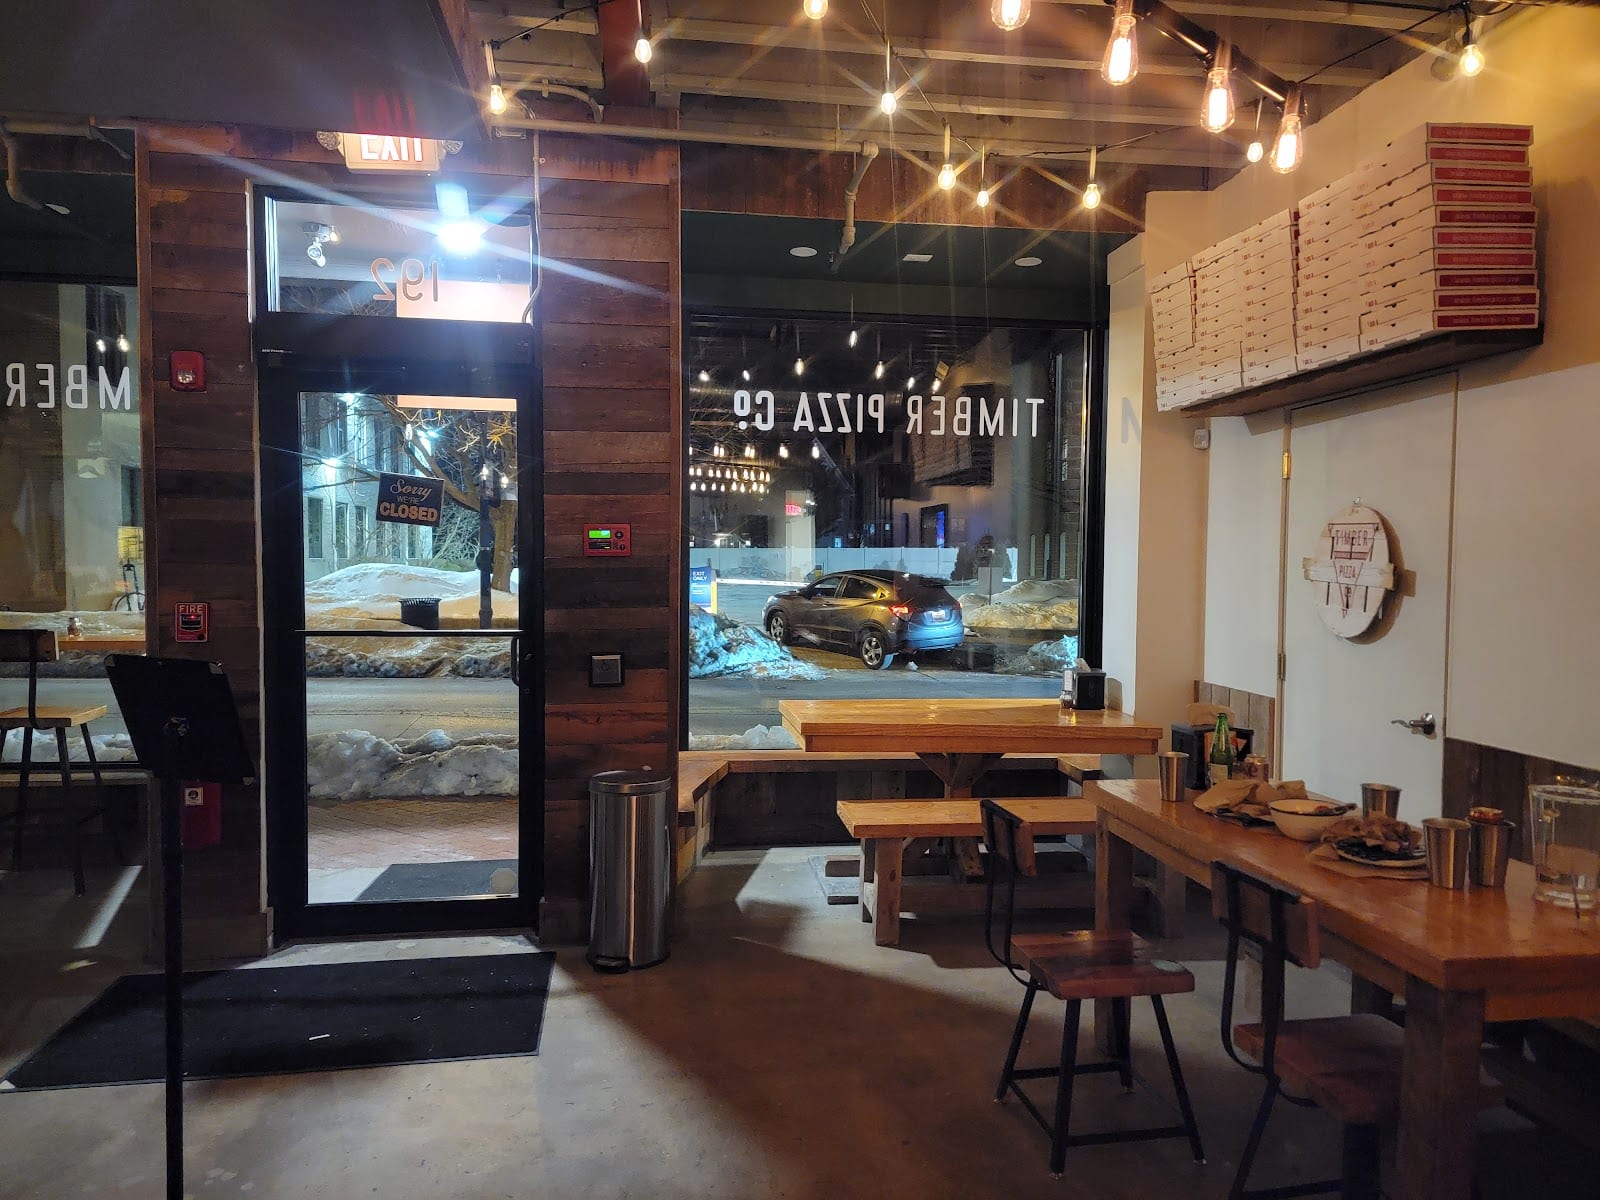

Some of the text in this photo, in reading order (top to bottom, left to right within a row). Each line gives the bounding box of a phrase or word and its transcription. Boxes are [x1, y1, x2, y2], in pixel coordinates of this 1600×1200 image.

[390, 479, 432, 501] Sorry
[397, 495, 420, 505] WE'RE
[380, 501, 438, 522] CLOSED
[180, 604, 204, 613] FIRE
